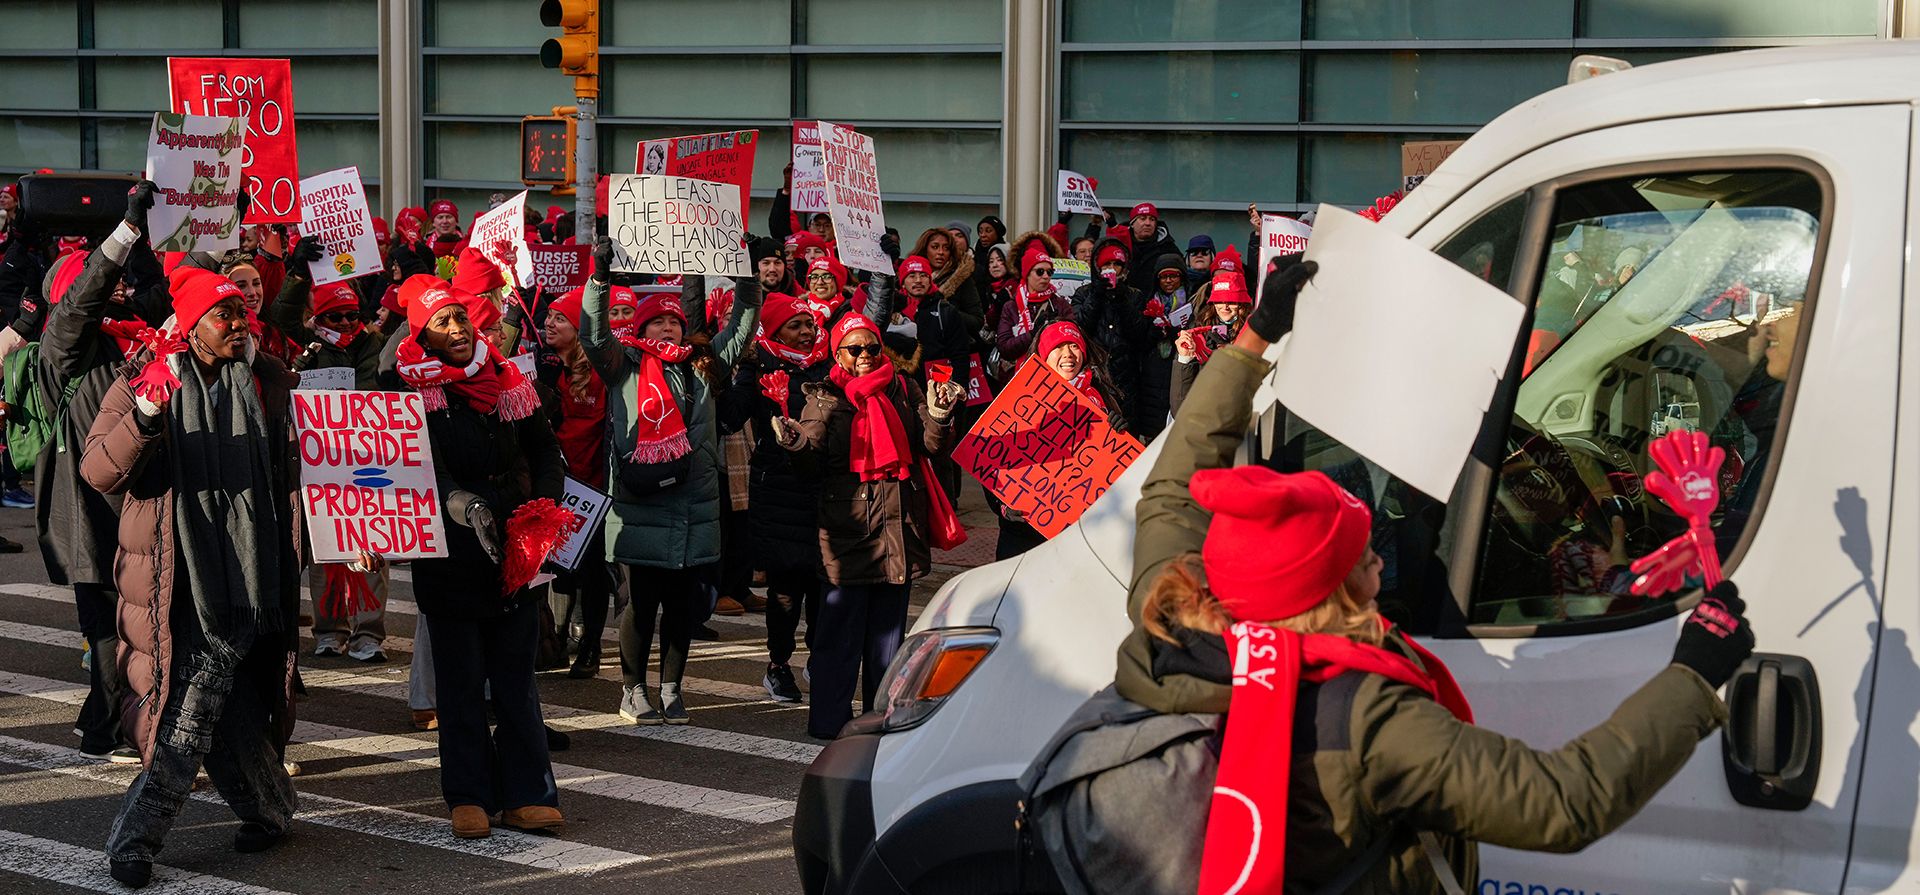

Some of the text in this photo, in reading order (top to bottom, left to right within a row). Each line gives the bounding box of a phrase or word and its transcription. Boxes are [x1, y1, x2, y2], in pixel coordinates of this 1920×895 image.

[201, 74, 265, 98] FROM
[832, 125, 865, 151] STOP
[193, 160, 216, 177] Was
[823, 140, 876, 177] PROFITING
[614, 176, 722, 204] AT LEAST
[826, 161, 878, 194] OFF NURSE
[249, 175, 296, 216] RO
[300, 182, 356, 208] HOSPITAL
[834, 184, 880, 215] BURNOUT
[304, 208, 363, 234] LITERALLY
[477, 205, 518, 235] HOSPITAL
[617, 201, 743, 230] THE BLOOD ON
[347, 222, 364, 239] US
[617, 224, 740, 252] OUR HANDS
[1269, 233, 1309, 250] HOSPIT
[326, 239, 356, 257] SICK
[615, 250, 745, 274] WASHES OFF
[533, 263, 580, 275] SERVE
[535, 274, 568, 286] OOD
[293, 392, 424, 431] NURSES
[1024, 357, 1142, 469] THINK WE
[1013, 394, 1099, 468] GIVING
[300, 429, 422, 467] OUTSIDE
[972, 427, 1073, 513] HOW LONG
[306, 483, 437, 517] PROBLEM
[972, 452, 1054, 527] WAIT TO
[334, 516, 437, 553] INSIDE
